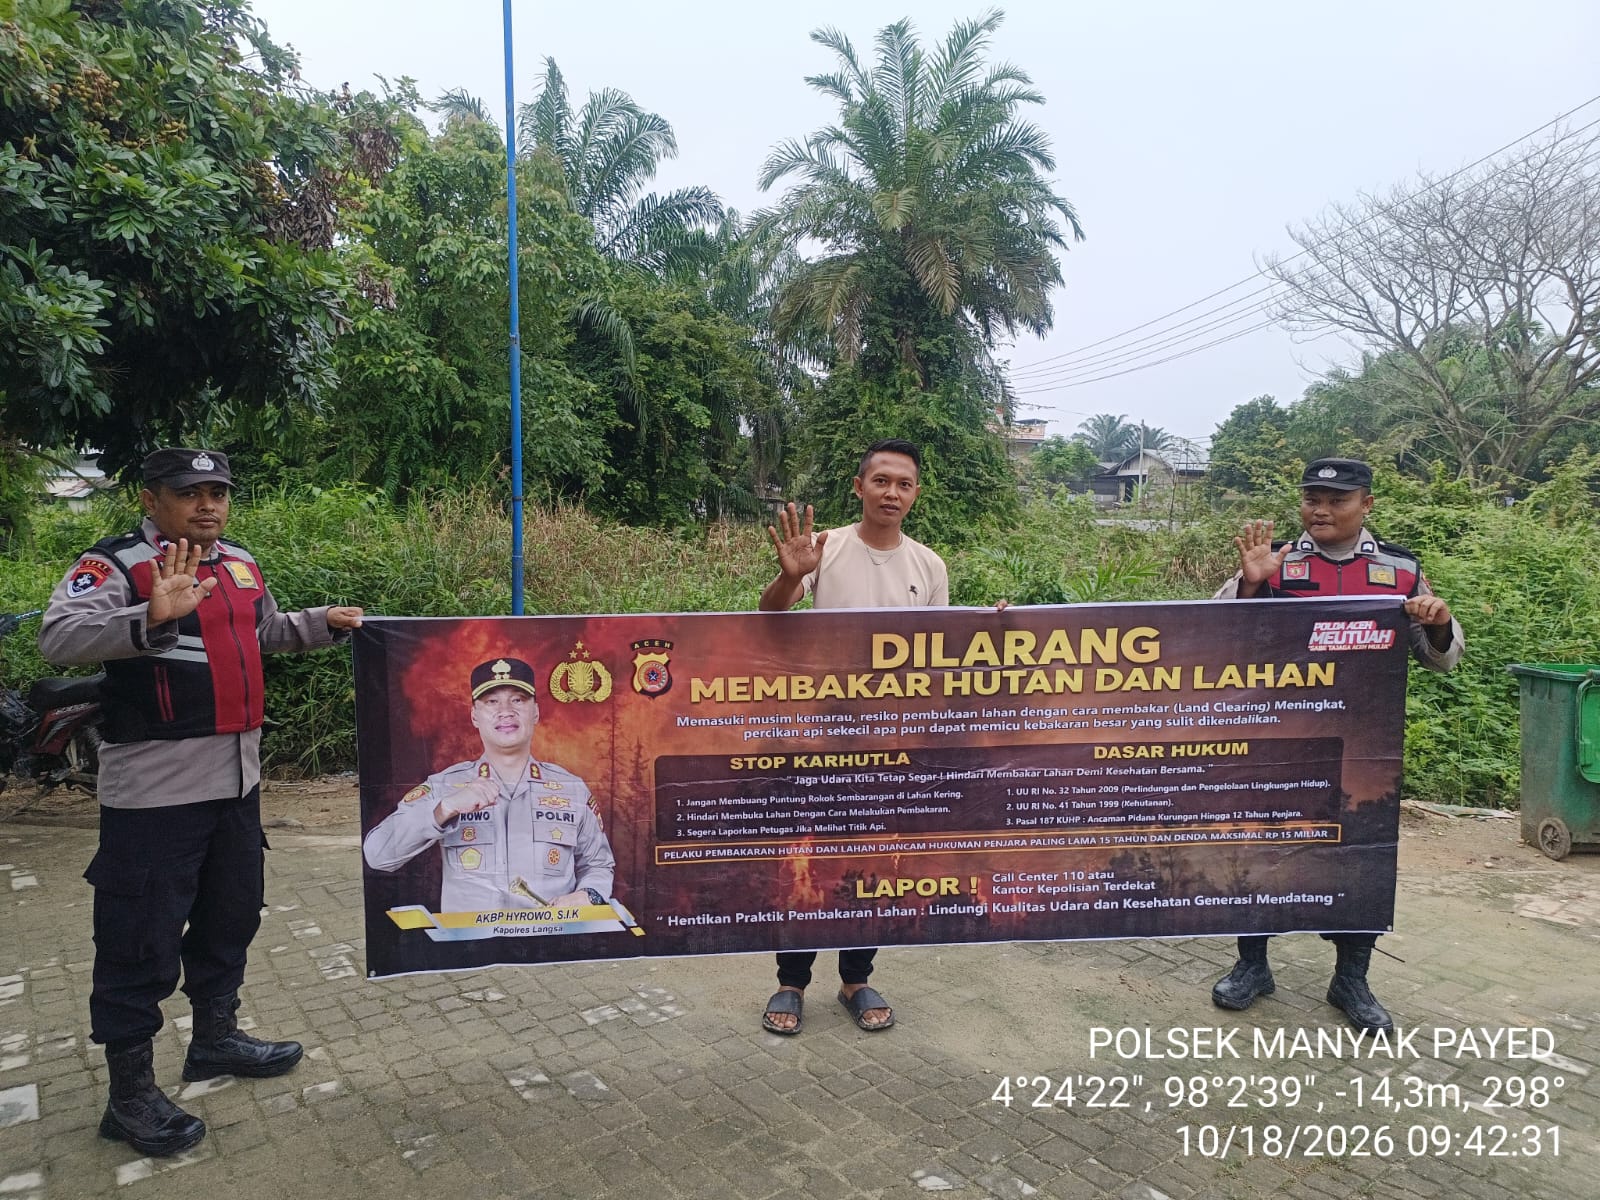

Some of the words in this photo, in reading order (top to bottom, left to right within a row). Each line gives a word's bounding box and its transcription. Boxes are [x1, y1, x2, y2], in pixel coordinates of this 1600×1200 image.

[1314, 622, 1345, 631] POLDA
[1346, 620, 1373, 630] ACEH
[635, 640, 671, 648] ACEH
[1309, 630, 1392, 645] MEUTUAH
[871, 626, 1161, 669] DILARANG
[690, 672, 931, 703] MEMBAKAR
[943, 668, 1083, 696] HUTAN
[1095, 666, 1182, 693] DAN
[1194, 662, 1336, 689] LAHAN
[676, 714, 744, 727] Memasuki
[748, 712, 792, 725] musim
[796, 711, 856, 724] kemarau,
[860, 710, 899, 722] resiko
[903, 708, 978, 722] pembukaan
[982, 708, 1018, 718] lahan
[1020, 705, 1068, 719] dengan
[1072, 707, 1098, 716] cara
[1102, 702, 1170, 714] membakar
[1173, 702, 1210, 714] (Land
[1214, 700, 1271, 715] Clearing)
[1275, 700, 1346, 713] Meningkat,
[744, 727, 800, 740] percikan
[803, 726, 824, 738] api
[827, 724, 870, 736] sekecil
[873, 725, 896, 736] apa
[900, 724, 926, 736] pun
[930, 722, 966, 734] dapat
[970, 722, 1020, 732] memicu
[1024, 718, 1090, 730] kebakaran
[1094, 718, 1128, 728] besar
[1130, 718, 1162, 730] yang
[1166, 715, 1194, 726] sulit
[1198, 713, 1282, 726] dikendalikan.
[1094, 744, 1164, 760] DASAR
[1171, 742, 1248, 758] HUKUM
[730, 756, 786, 770] STOP
[794, 752, 911, 769] KARHUTLA
[795, 776, 818, 786] Jaga
[821, 774, 851, 784] Udara
[855, 774, 874, 783] Kita
[878, 773, 906, 784] Tetap
[947, 771, 983, 779] Hindari
[986, 770, 1041, 779] Membakar
[1044, 769, 1073, 777] Lahan
[1077, 767, 1102, 776] Demi
[1106, 766, 1157, 775] Kesehatan
[1160, 766, 1206, 774] Bersama.
[1042, 787, 1056, 795] No.
[1072, 786, 1096, 794] Tahun
[1122, 785, 1179, 794] (Perlindungan
[1182, 783, 1196, 791] dan
[1199, 782, 1249, 792] Pengelolaan
[1252, 781, 1298, 791] Lingkungan
[1301, 780, 1330, 789] Hidup).
[686, 799, 716, 808] Jangan
[719, 797, 767, 806] Membuang
[770, 796, 805, 804] Puntung
[837, 793, 894, 802] Sembarangan
[907, 791, 931, 799] Lahan
[934, 791, 963, 799] Kering.
[1032, 802, 1039, 810] RI
[1042, 802, 1056, 810] No.
[1059, 801, 1068, 809] 41
[1099, 800, 1118, 808] 1999
[1122, 799, 1174, 808] (Kehutanan).
[536, 811, 575, 822] POLRI
[687, 812, 718, 821] Hindari
[721, 812, 763, 820] Membuka
[794, 810, 825, 819] Dengan
[828, 809, 846, 817] Cara
[850, 808, 895, 816] Melakukan
[898, 806, 951, 814] Pembakaran.
[1016, 817, 1036, 825] Pasal
[1057, 816, 1080, 824] KUHP
[1088, 816, 1125, 824] Ancaman
[1128, 814, 1155, 822] Pidana
[1158, 813, 1198, 822] Kurungan
[1201, 812, 1230, 821] Hingga
[1233, 811, 1242, 819] 12
[1272, 810, 1303, 819] Penjara.
[687, 828, 716, 838] Segera
[719, 827, 757, 836] Laporkan
[760, 826, 793, 835] Petugas
[795, 825, 811, 833] Jika
[815, 824, 846, 832] Melihat
[849, 823, 867, 831] Titik
[870, 823, 886, 832] Api.
[664, 851, 702, 859] PELAKU
[706, 848, 775, 857] PEMBAKARAN
[779, 847, 812, 855] HUTAN
[841, 844, 878, 852] LAHAN
[880, 842, 926, 851] DIANCAM
[929, 841, 981, 849] HUKUMAN
[984, 839, 1027, 848] PENJARA
[1030, 838, 1064, 846] PALING
[1068, 837, 1096, 845] LAMA
[1113, 835, 1147, 843] TAHUN
[1150, 834, 1171, 842] DAN
[1175, 833, 1207, 841] DENDA
[1211, 831, 1263, 840] MAKSIMAL
[1266, 831, 1278, 839] RP
[1281, 831, 1291, 839] 15
[1294, 830, 1328, 838] MILIAR
[992, 872, 1014, 882] Call
[1018, 872, 1058, 882] Center
[1062, 871, 1084, 881] 110
[1088, 870, 1115, 880] atau
[856, 877, 960, 898] LAPOR
[992, 884, 1033, 895] Kantor
[1037, 882, 1100, 896] Kepolisian
[1104, 881, 1156, 892] Terdekat
[476, 912, 504, 924] AKBP
[506, 910, 554, 922] HYROWO,
[557, 908, 579, 920] S.I.K
[668, 914, 731, 926] Hentikan
[736, 911, 784, 923] Praktik
[788, 908, 872, 921] Pembakaran
[877, 906, 917, 918] Lahan
[930, 903, 988, 916] Lindungi
[992, 901, 1046, 914] Kualitas
[1050, 900, 1090, 912] Udara
[1094, 899, 1118, 910] dan
[1123, 897, 1191, 909] Kesehatan
[1194, 894, 1252, 906] Generasi
[1256, 892, 1334, 906] Mendatang
[493, 926, 530, 936] Kapolres
[532, 924, 563, 935] Langsa
